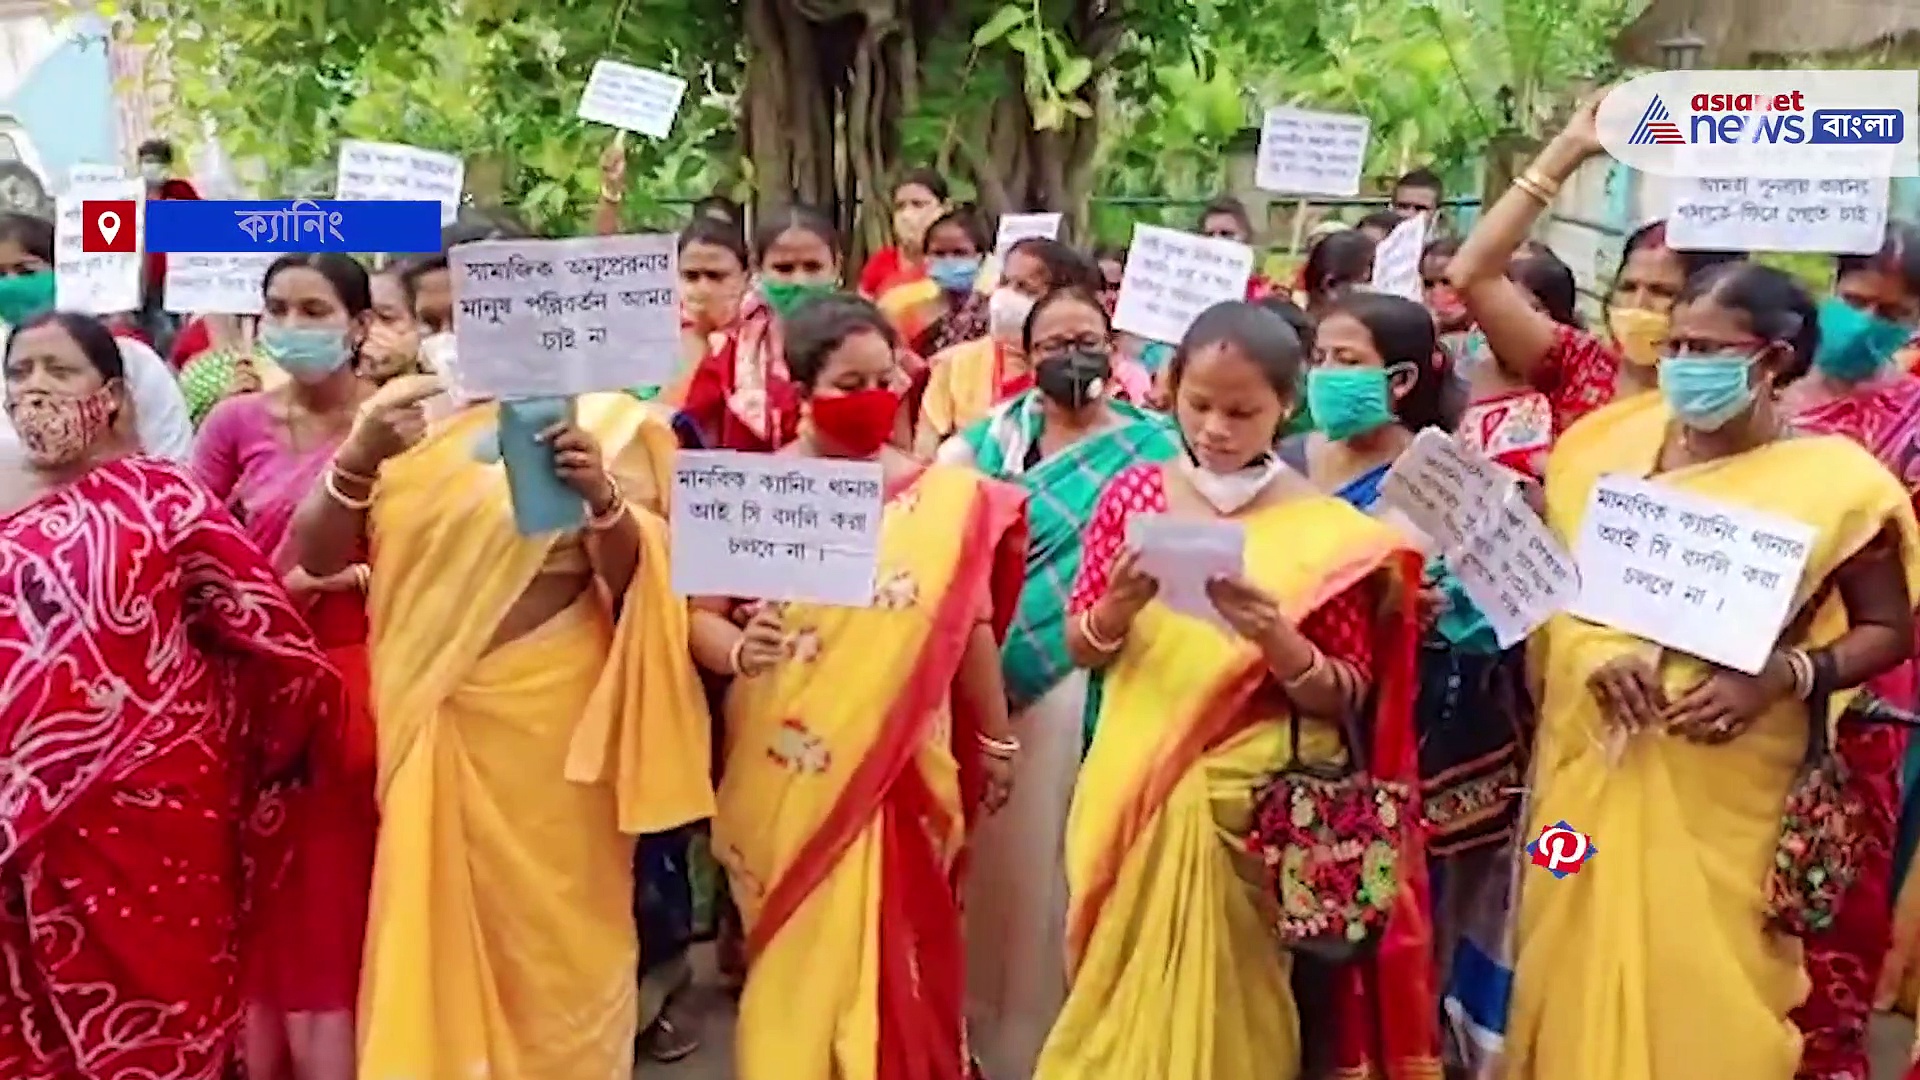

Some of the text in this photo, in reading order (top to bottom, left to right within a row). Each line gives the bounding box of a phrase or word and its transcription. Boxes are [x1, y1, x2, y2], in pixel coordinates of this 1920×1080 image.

[460, 297, 513, 324] মানুষ
[540, 326, 607, 351] চাই না
